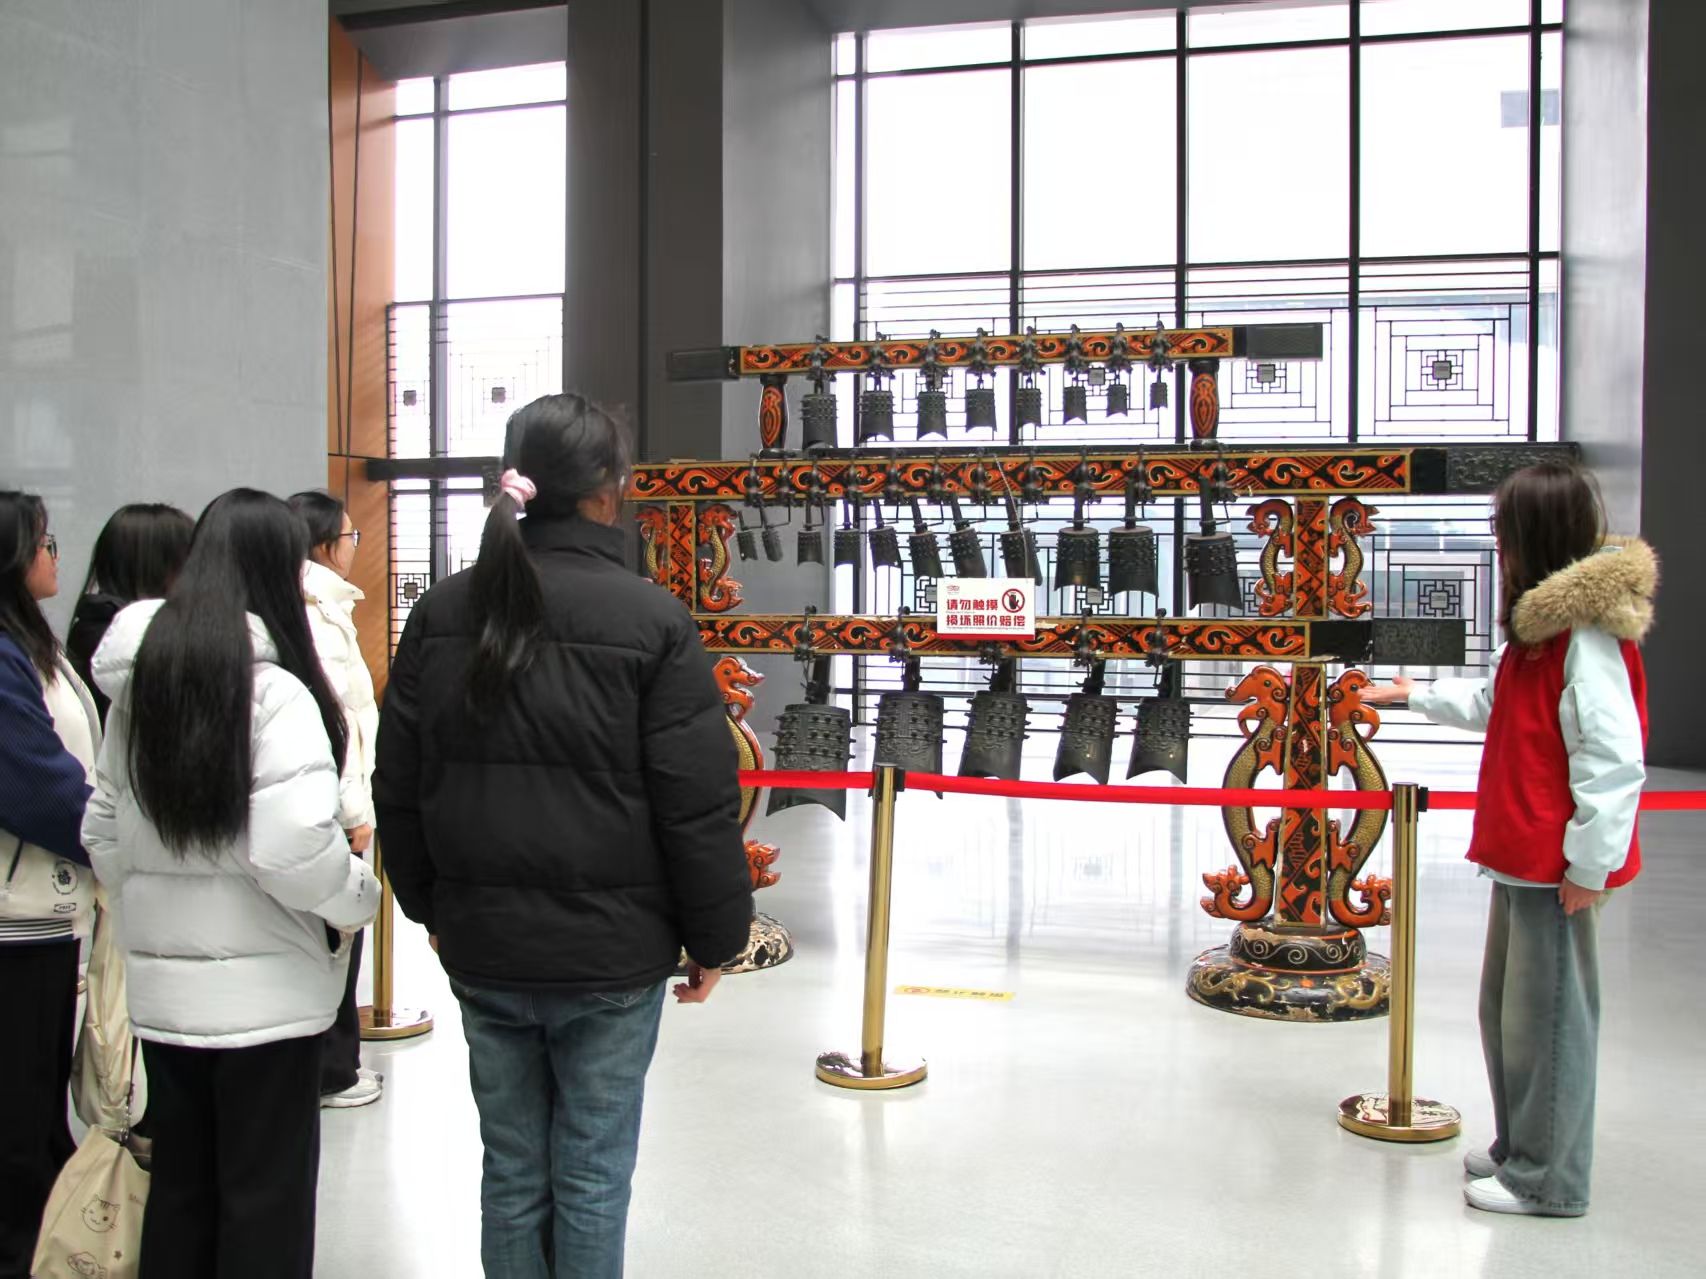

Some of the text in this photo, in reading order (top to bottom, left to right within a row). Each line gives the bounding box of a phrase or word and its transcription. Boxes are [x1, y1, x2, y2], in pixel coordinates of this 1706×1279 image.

[946, 599, 998, 610] 请勿触摸
[946, 614, 1025, 626] 损坏照价赔偿
